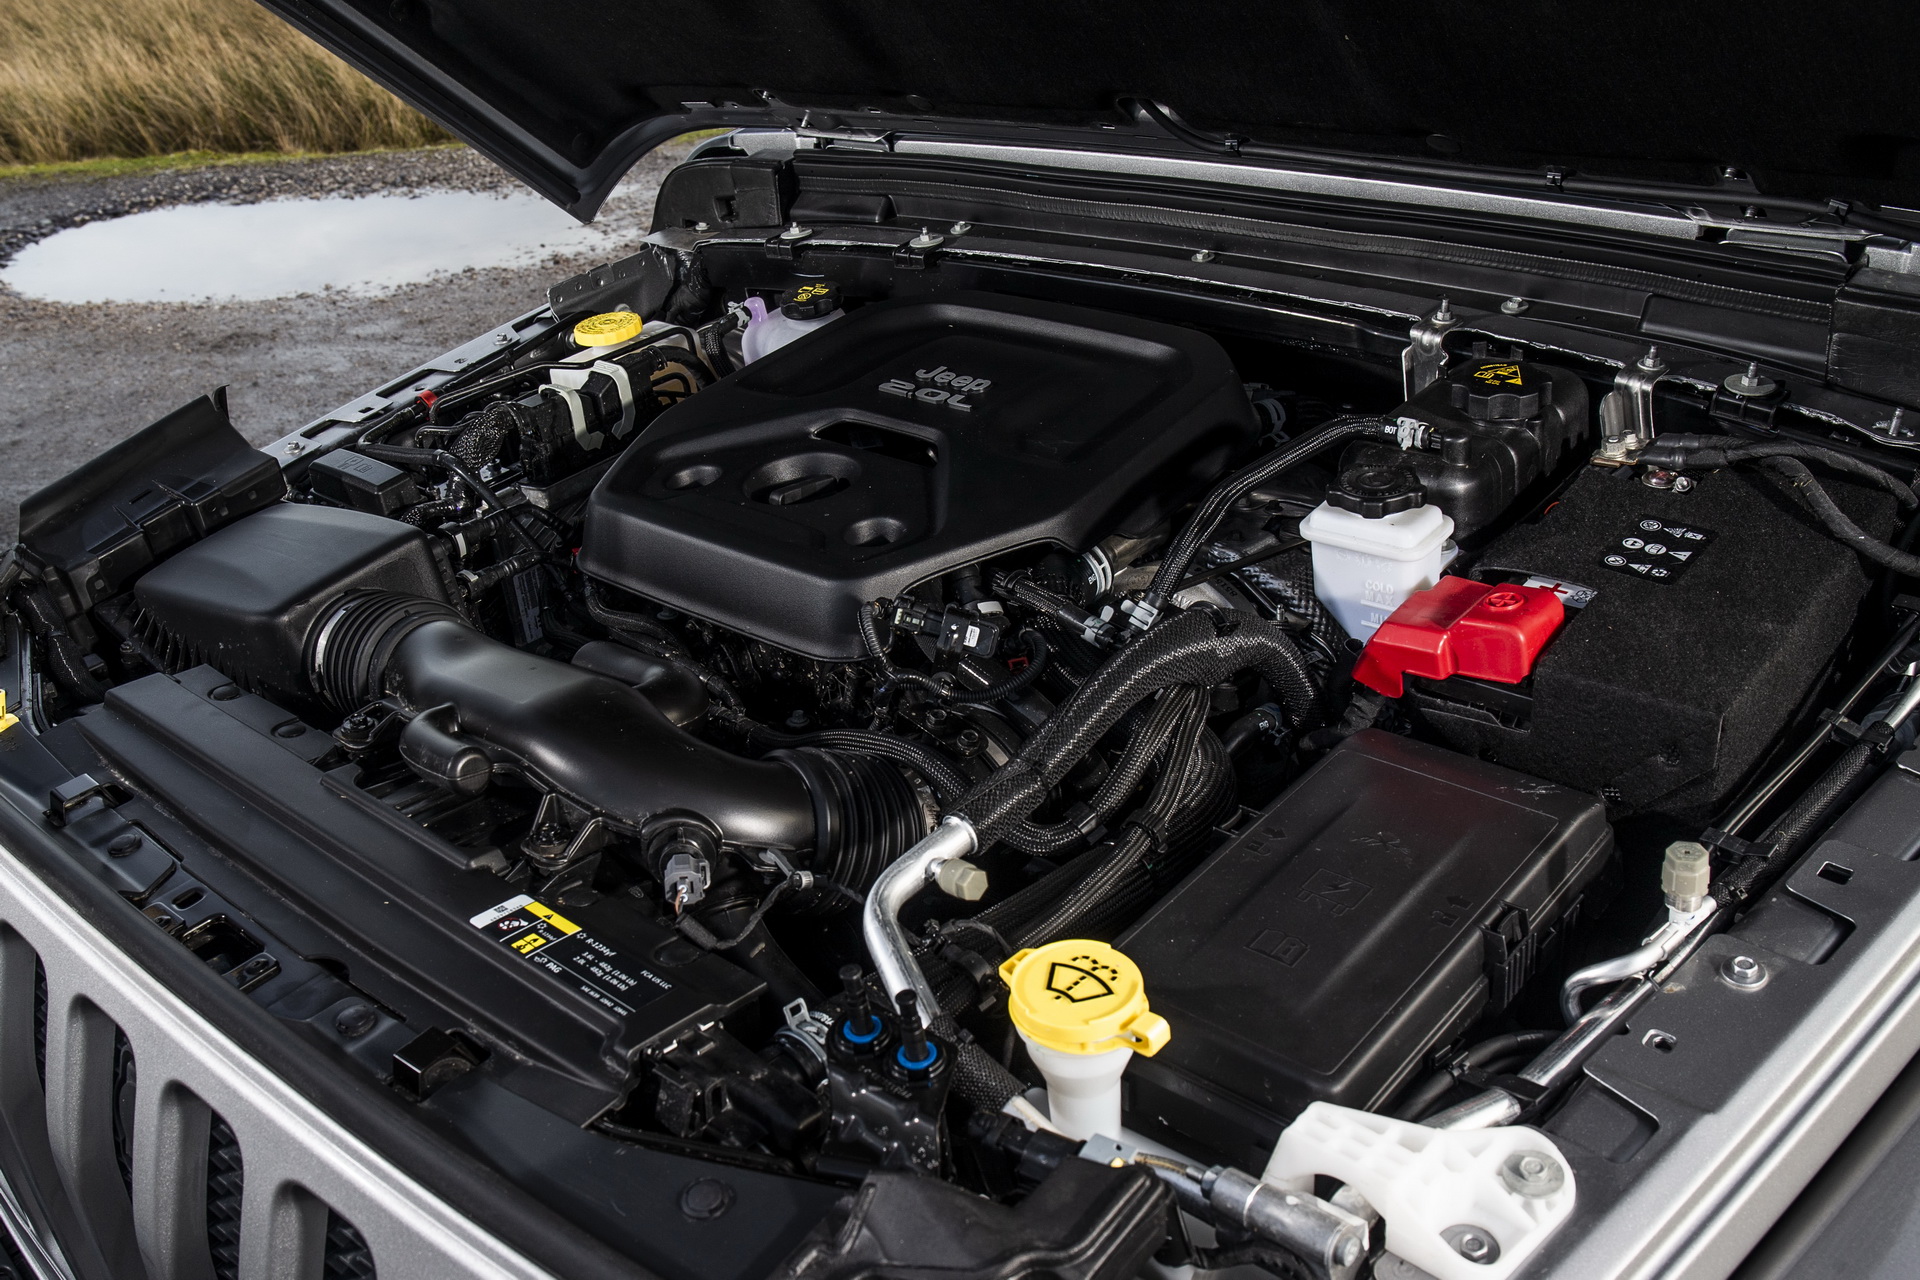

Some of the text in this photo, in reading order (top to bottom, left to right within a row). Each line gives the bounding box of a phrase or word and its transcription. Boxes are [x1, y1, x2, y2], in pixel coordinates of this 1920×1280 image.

[915, 366, 992, 395] Jeep
[879, 379, 972, 412] 2.0L
[1365, 580, 1394, 595] COLD
[1365, 590, 1394, 607] MAX
[545, 962, 562, 974] PAG
